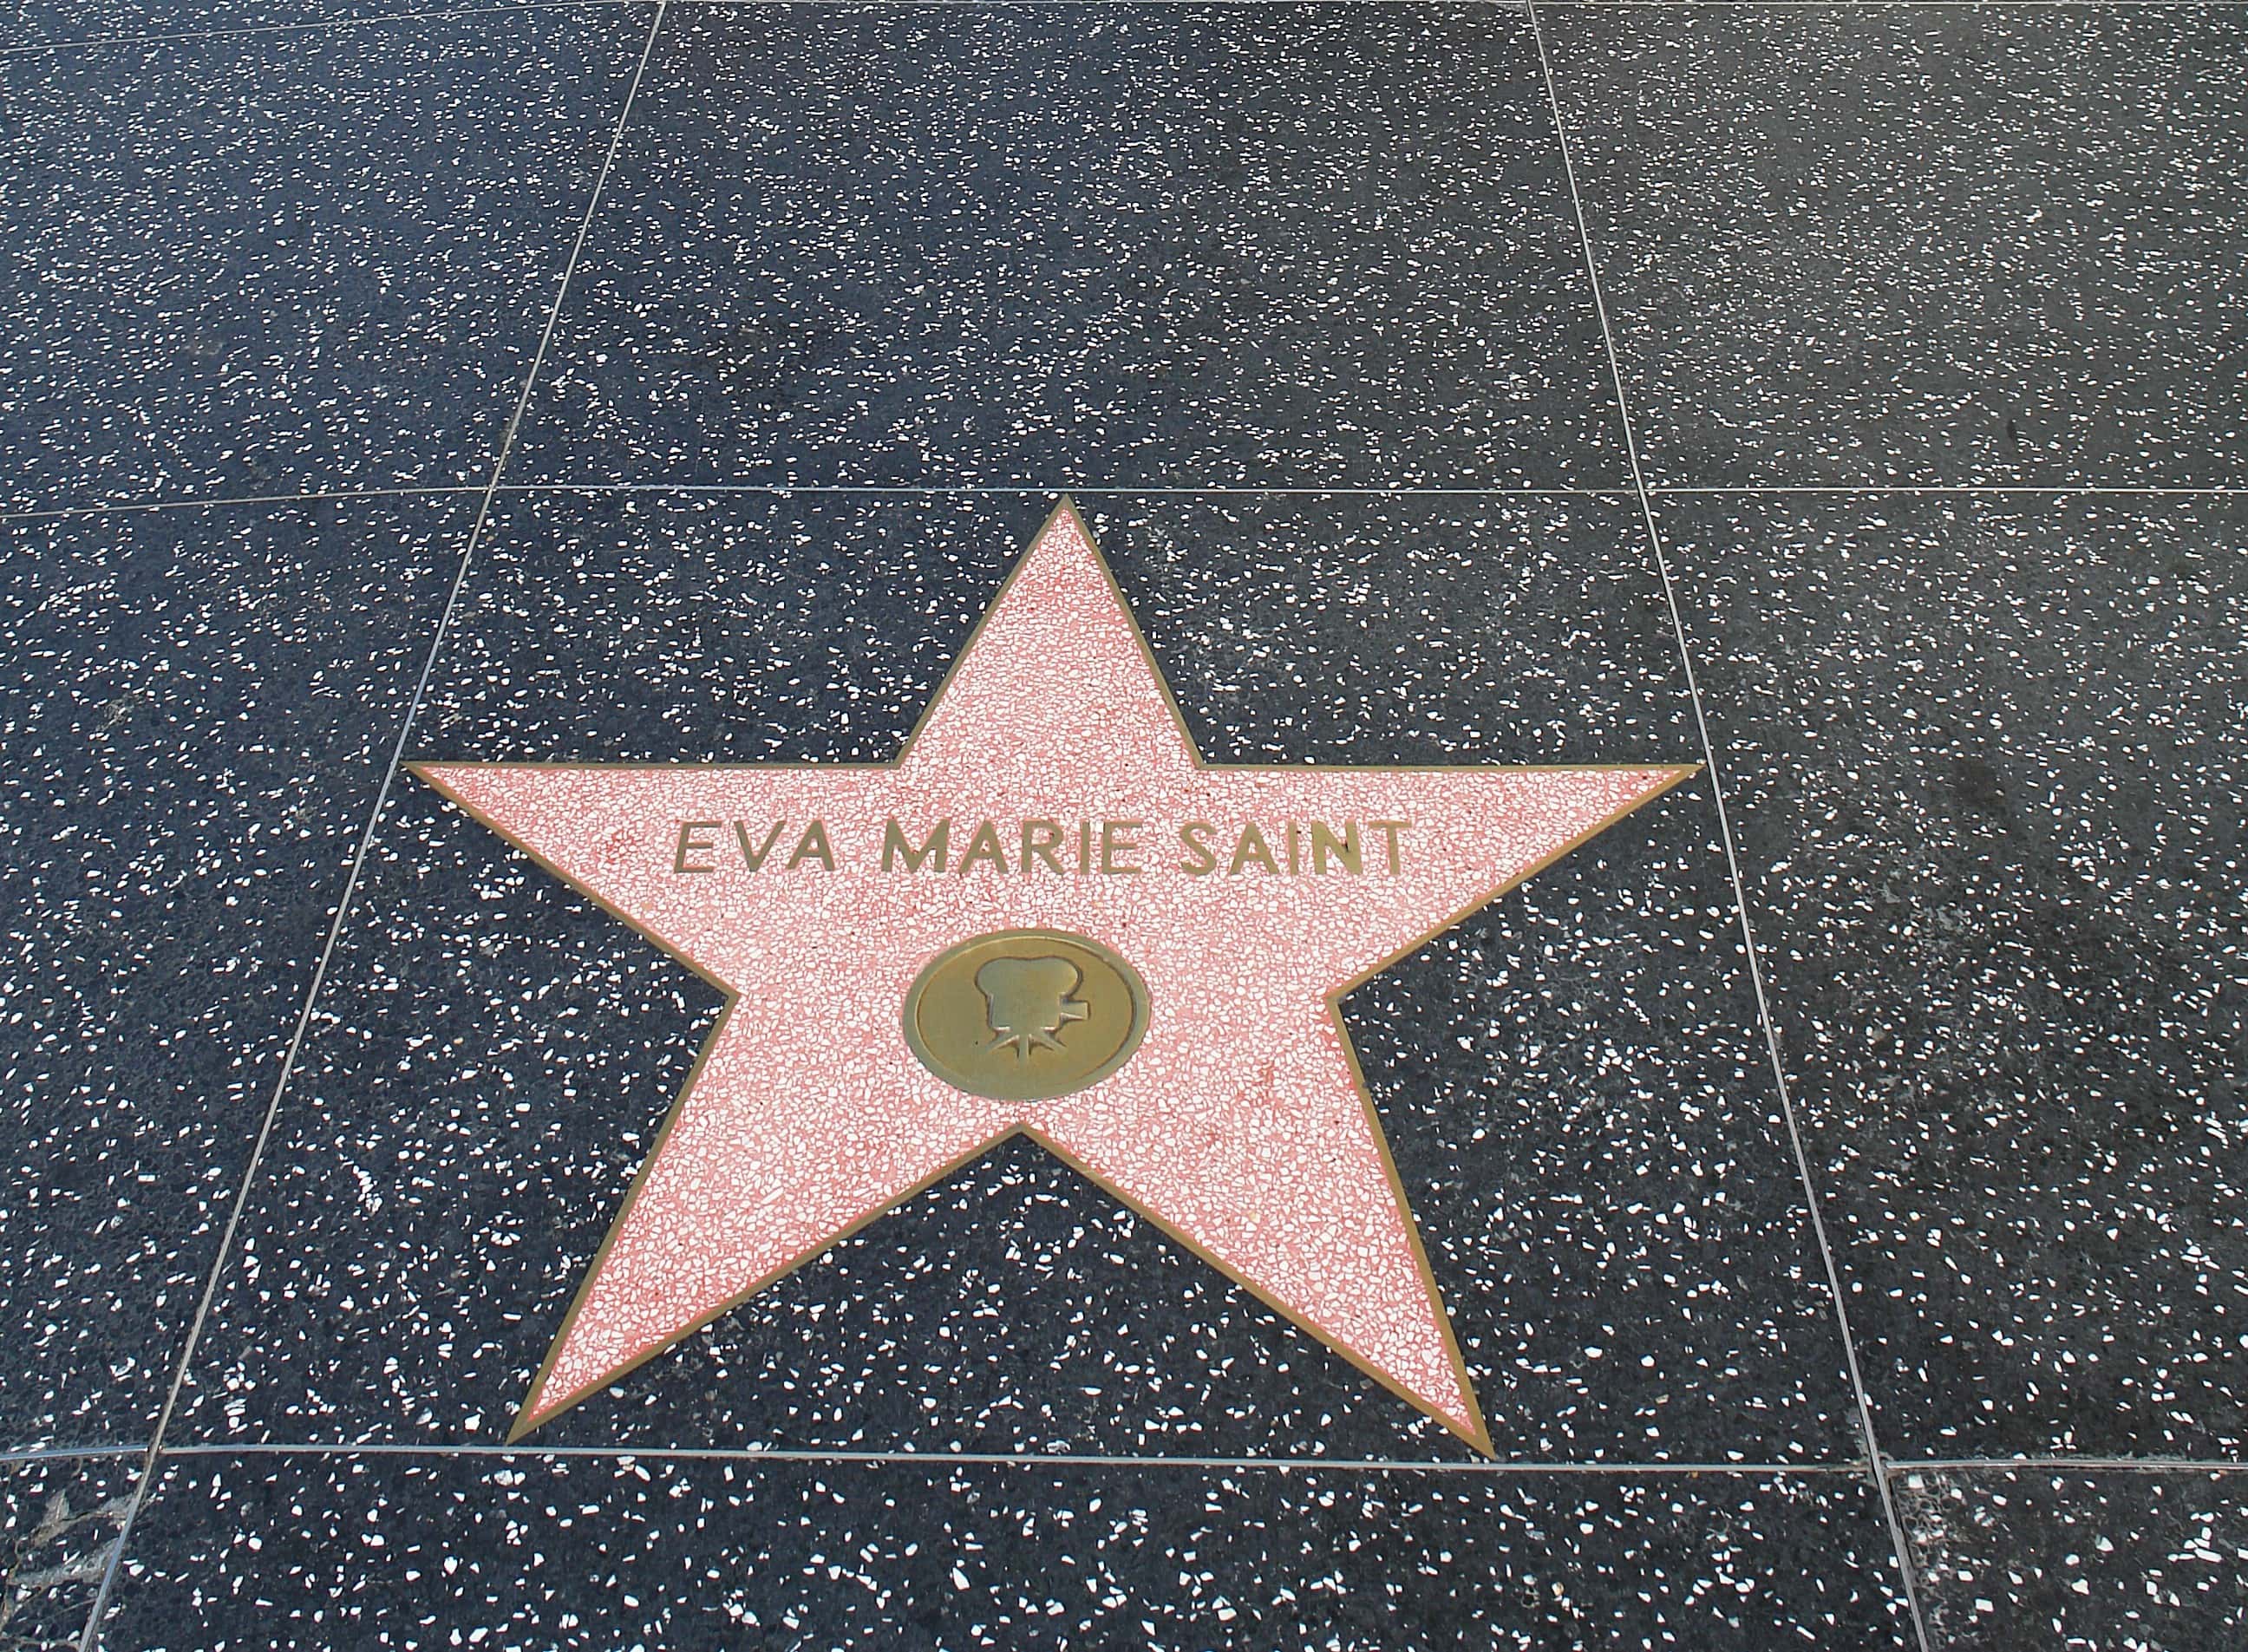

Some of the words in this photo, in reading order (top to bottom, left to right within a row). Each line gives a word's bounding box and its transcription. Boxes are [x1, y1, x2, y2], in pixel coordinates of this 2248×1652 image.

[673, 820, 836, 873] EVA
[880, 819, 1144, 875] MARIE
[1178, 819, 1414, 876] SAINT
